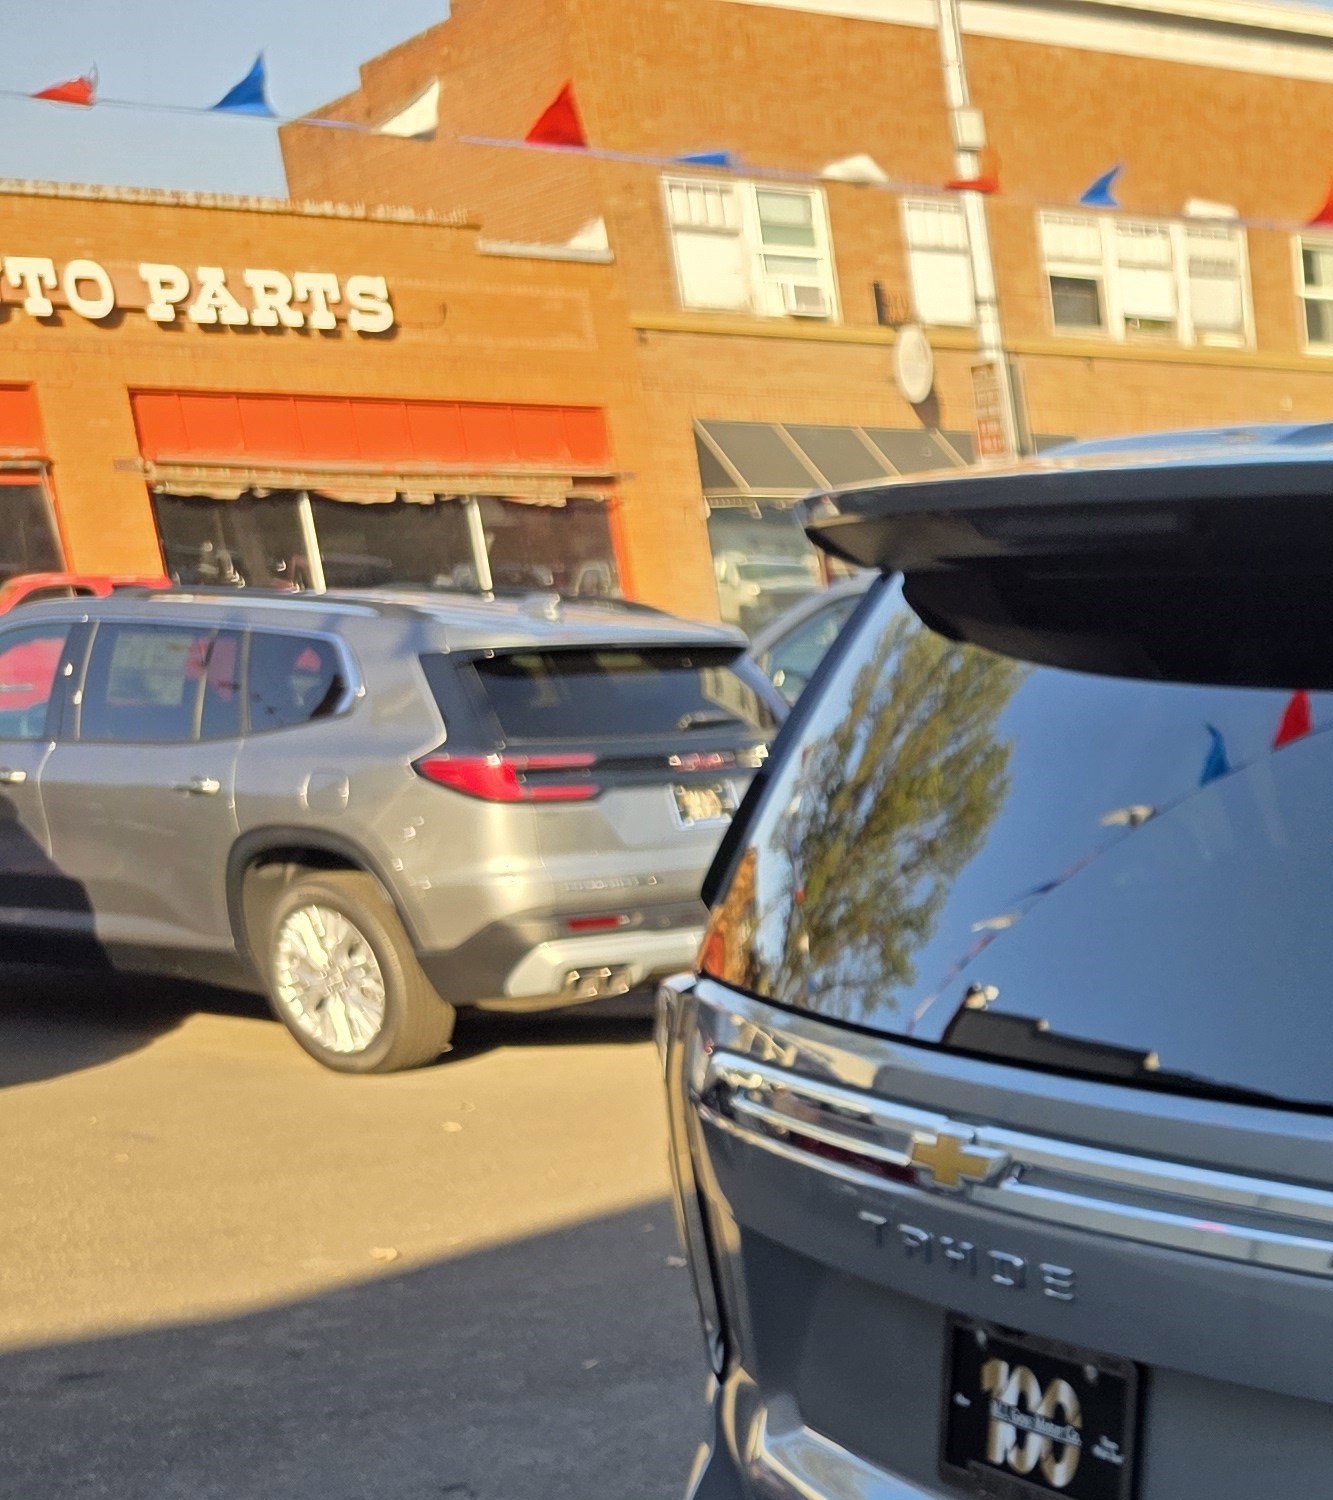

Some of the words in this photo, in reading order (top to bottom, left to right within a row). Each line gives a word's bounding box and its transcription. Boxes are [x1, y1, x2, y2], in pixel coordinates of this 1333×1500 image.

[0, 256, 115, 319] TO
[139, 262, 394, 333] PARTS
[858, 1210, 1077, 1301] TAHOE
